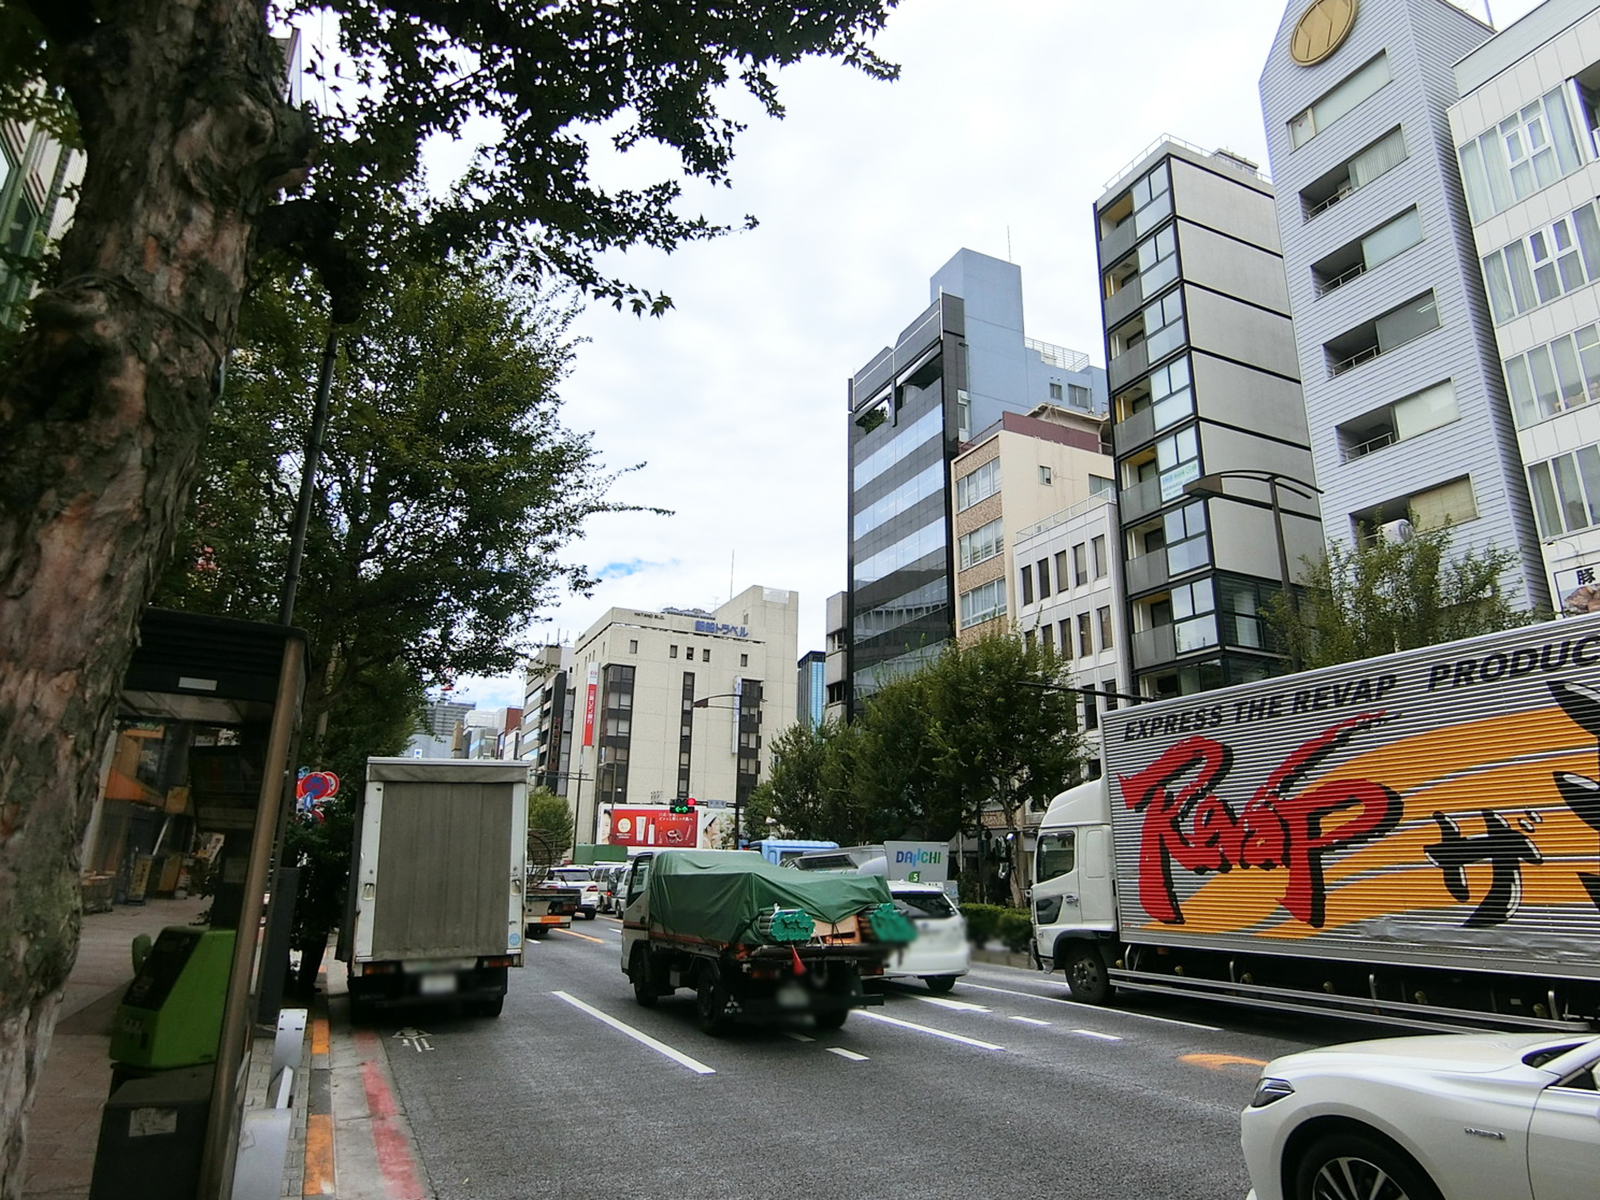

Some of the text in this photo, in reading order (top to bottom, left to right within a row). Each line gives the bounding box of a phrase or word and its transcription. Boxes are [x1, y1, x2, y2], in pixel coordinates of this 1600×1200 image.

[1576, 567, 1596, 585] 豚
[1124, 635, 1600, 742] EXPRESS THE REVAP PRODUC
[895, 848, 941, 867] DAIICHI
